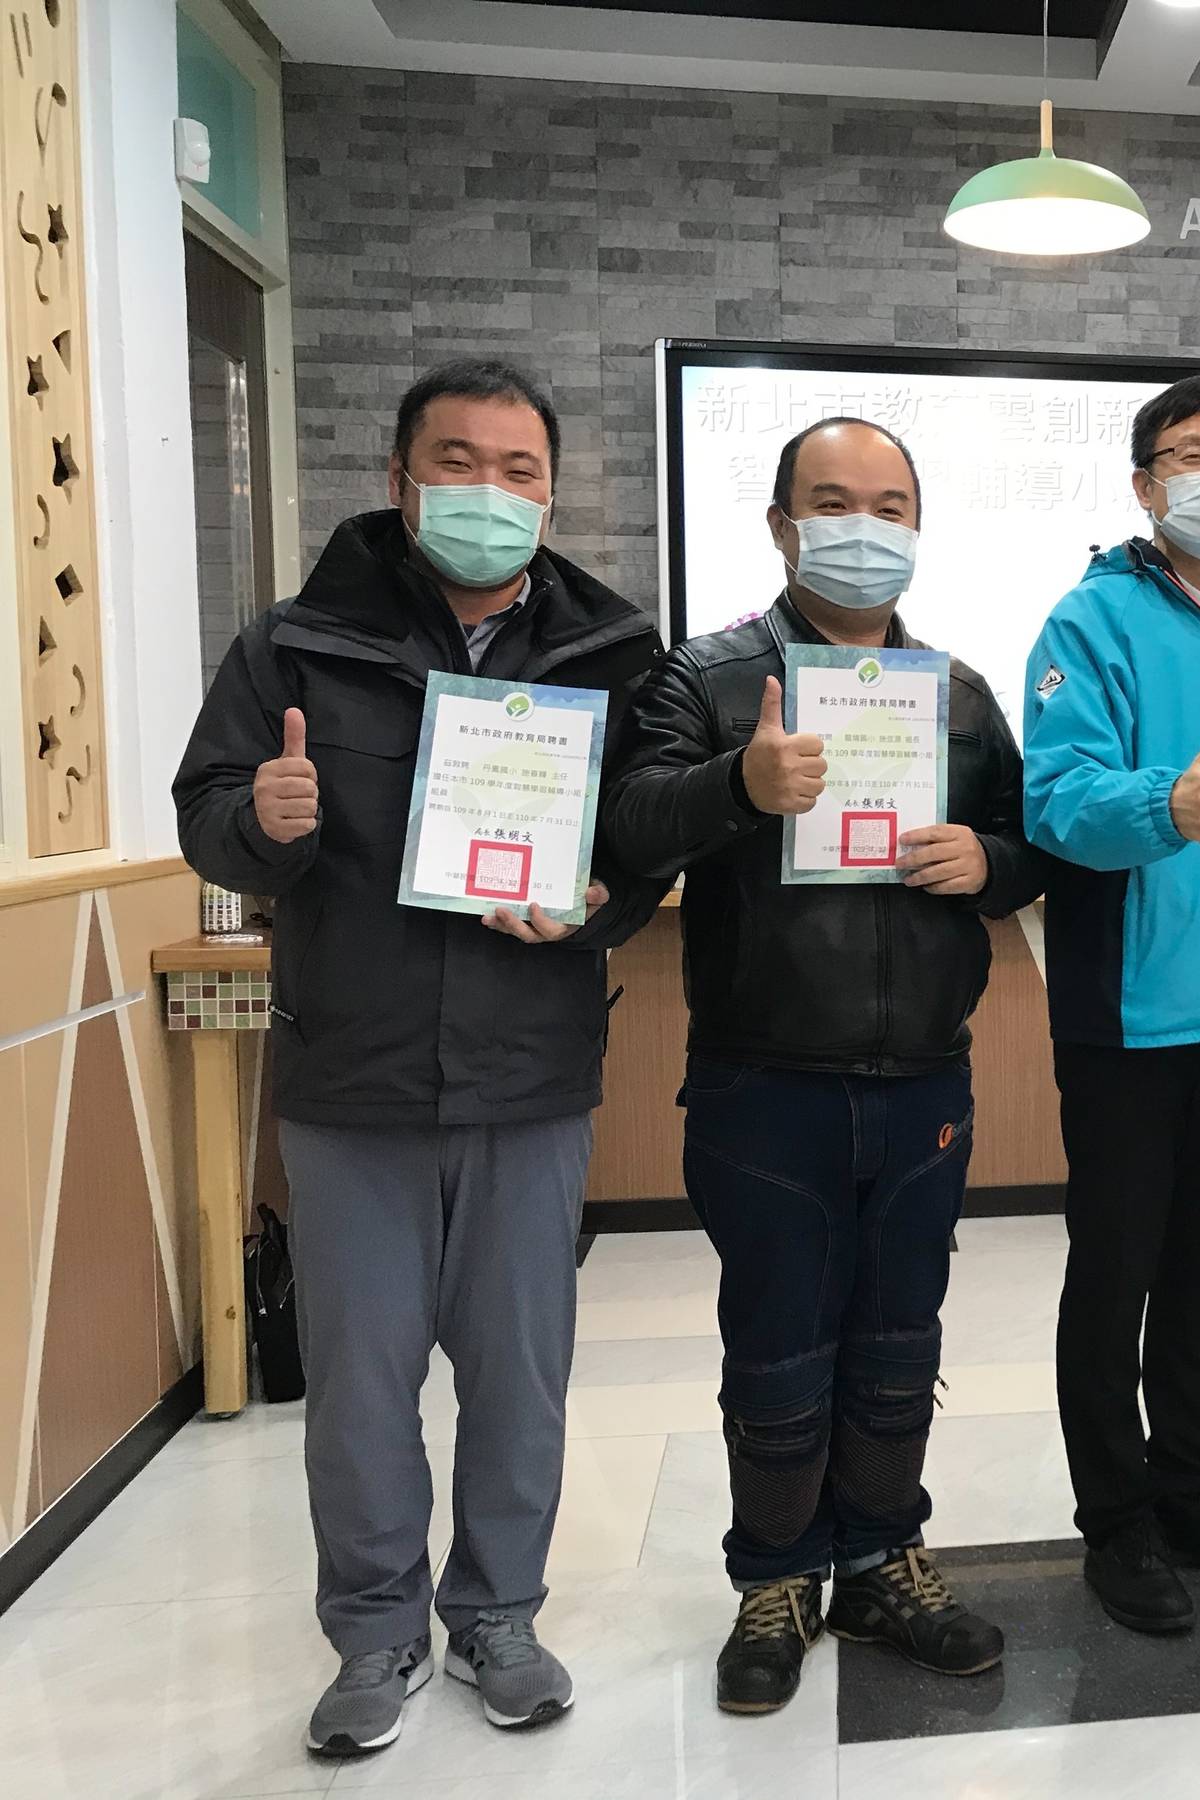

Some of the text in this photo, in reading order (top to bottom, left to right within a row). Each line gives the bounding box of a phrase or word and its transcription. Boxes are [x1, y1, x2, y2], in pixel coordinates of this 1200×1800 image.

[459, 725, 568, 746] 新北市政府教育局聘書
